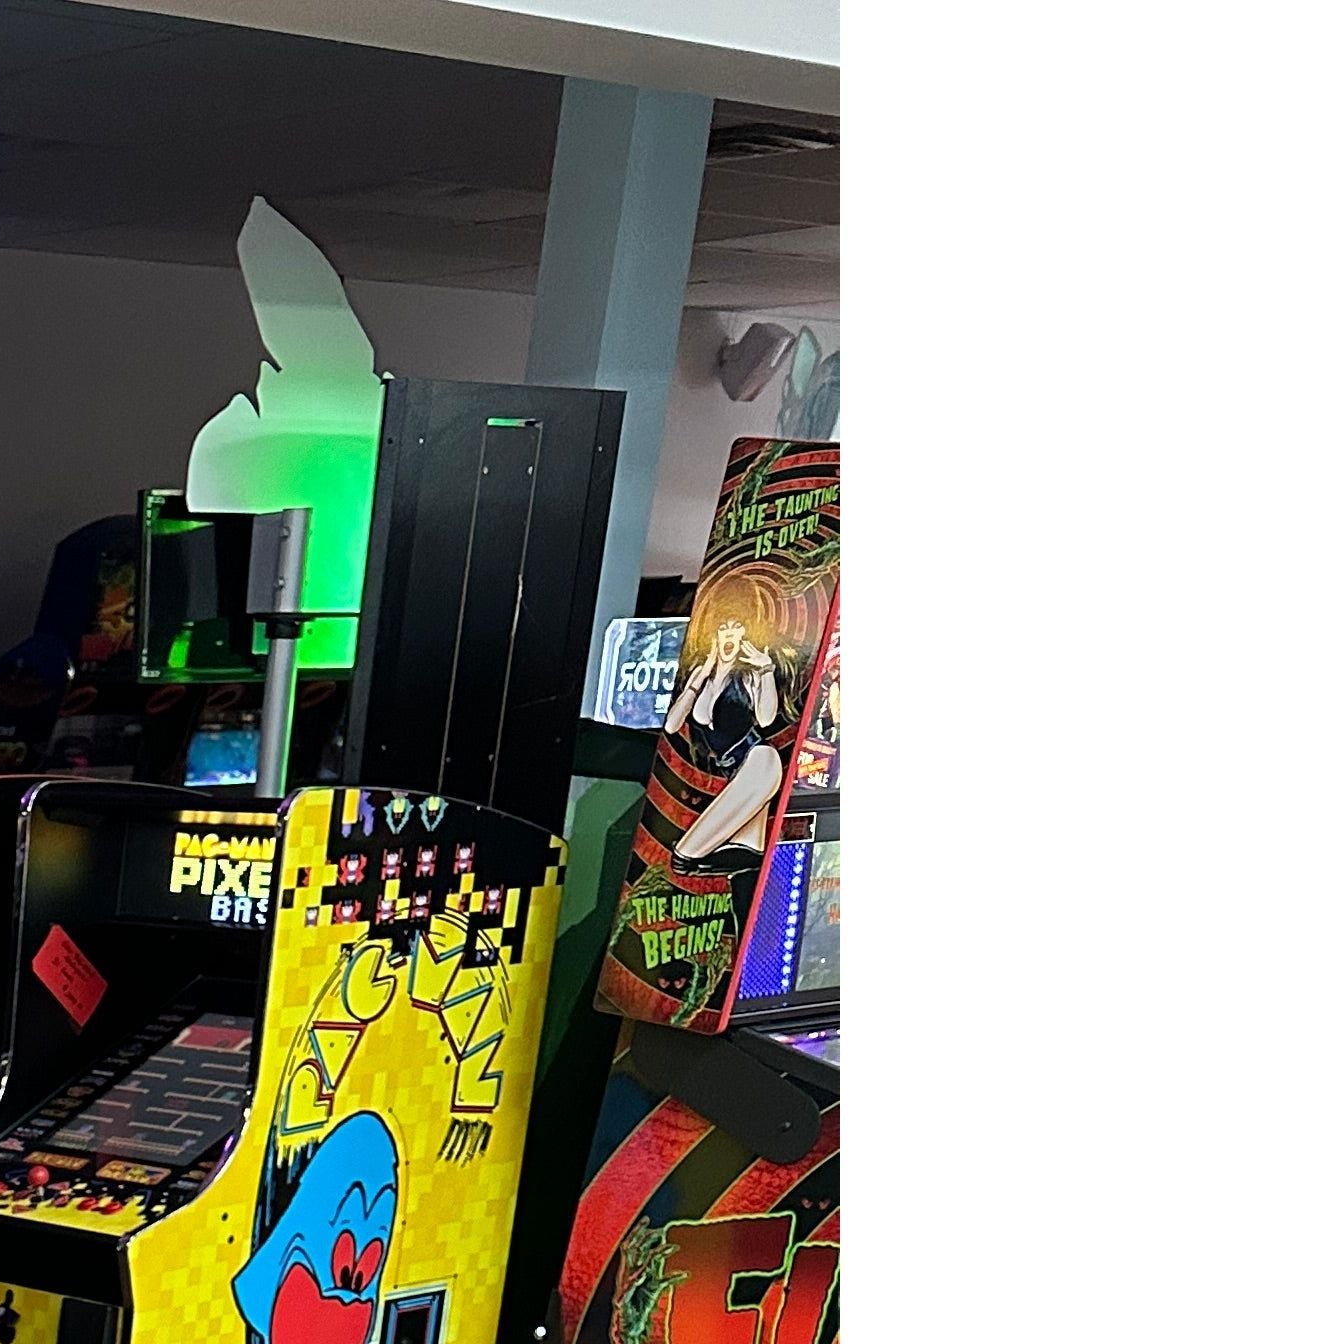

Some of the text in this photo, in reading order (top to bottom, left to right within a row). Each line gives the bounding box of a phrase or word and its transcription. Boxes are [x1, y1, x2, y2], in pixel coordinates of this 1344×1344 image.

[728, 503, 768, 538] THE
[755, 513, 819, 559] IS OVER!
[175, 832, 277, 861] PAC-MAN
[169, 856, 274, 898] PIXE
[632, 893, 732, 926] THE HAUNTING
[642, 919, 725, 969] BEGINS!
